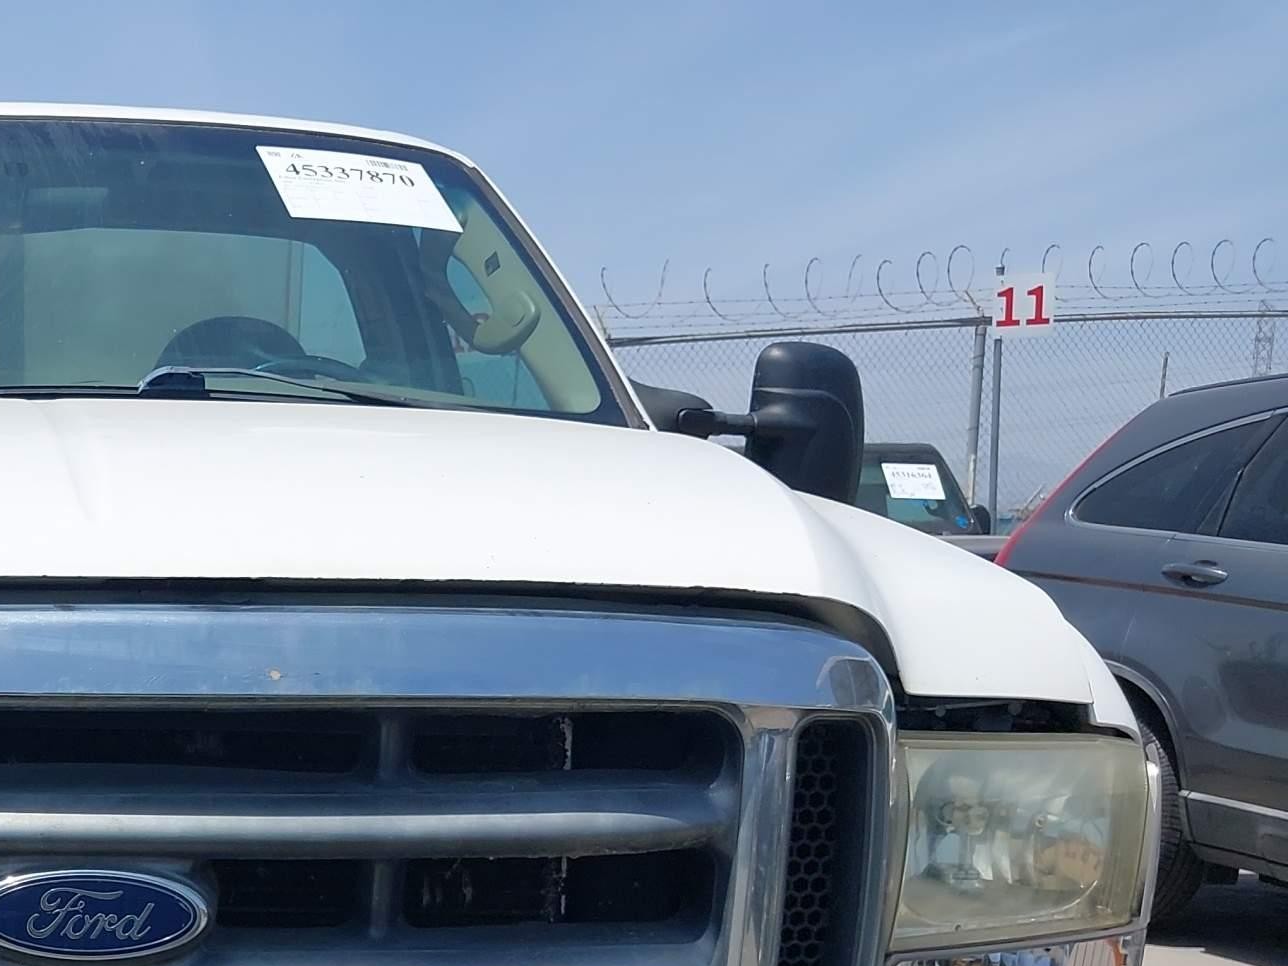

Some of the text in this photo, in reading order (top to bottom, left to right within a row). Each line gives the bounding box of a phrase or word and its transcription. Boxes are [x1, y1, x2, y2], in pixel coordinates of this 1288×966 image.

[285, 163, 416, 188] 45337870
[995, 285, 1050, 328] 11
[25, 886, 155, 941] Ford
